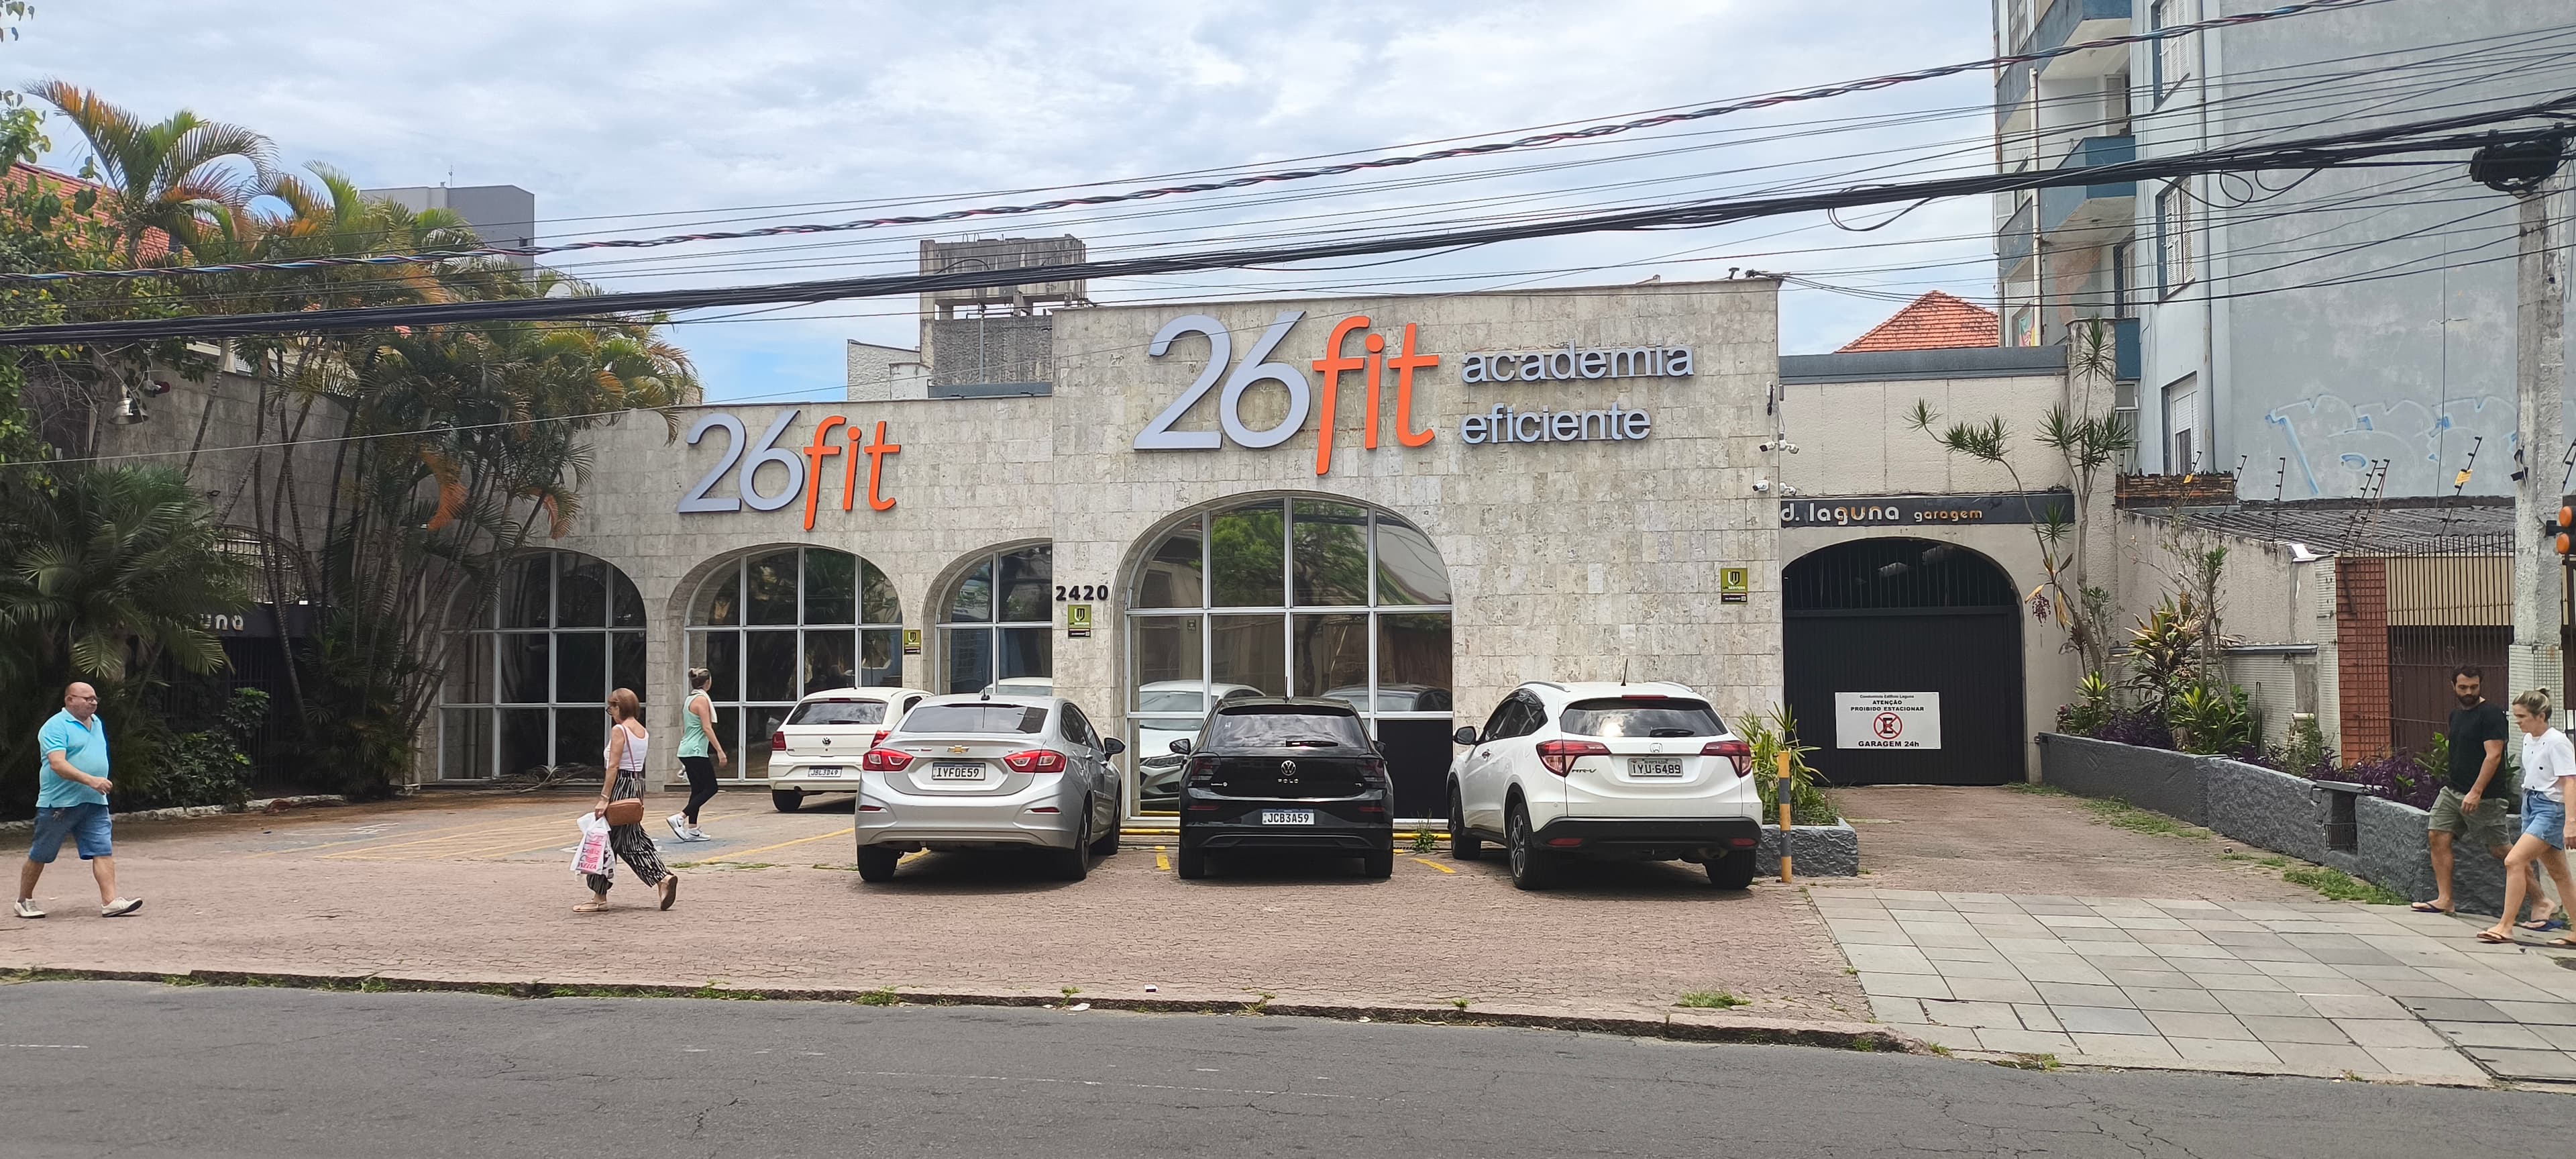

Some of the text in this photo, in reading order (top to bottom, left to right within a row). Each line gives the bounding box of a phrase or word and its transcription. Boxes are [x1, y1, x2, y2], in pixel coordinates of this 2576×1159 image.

[1462, 338, 1695, 384] academia
[1133, 310, 1440, 476] 26fit
[1461, 403, 1652, 444] eficiente
[678, 409, 902, 532] 26fit
[1809, 503, 1900, 525] laguna
[1914, 510, 1983, 523] garagem
[1056, 585, 1108, 601] 2420
[1267, 813, 1309, 823] JCB3A59
